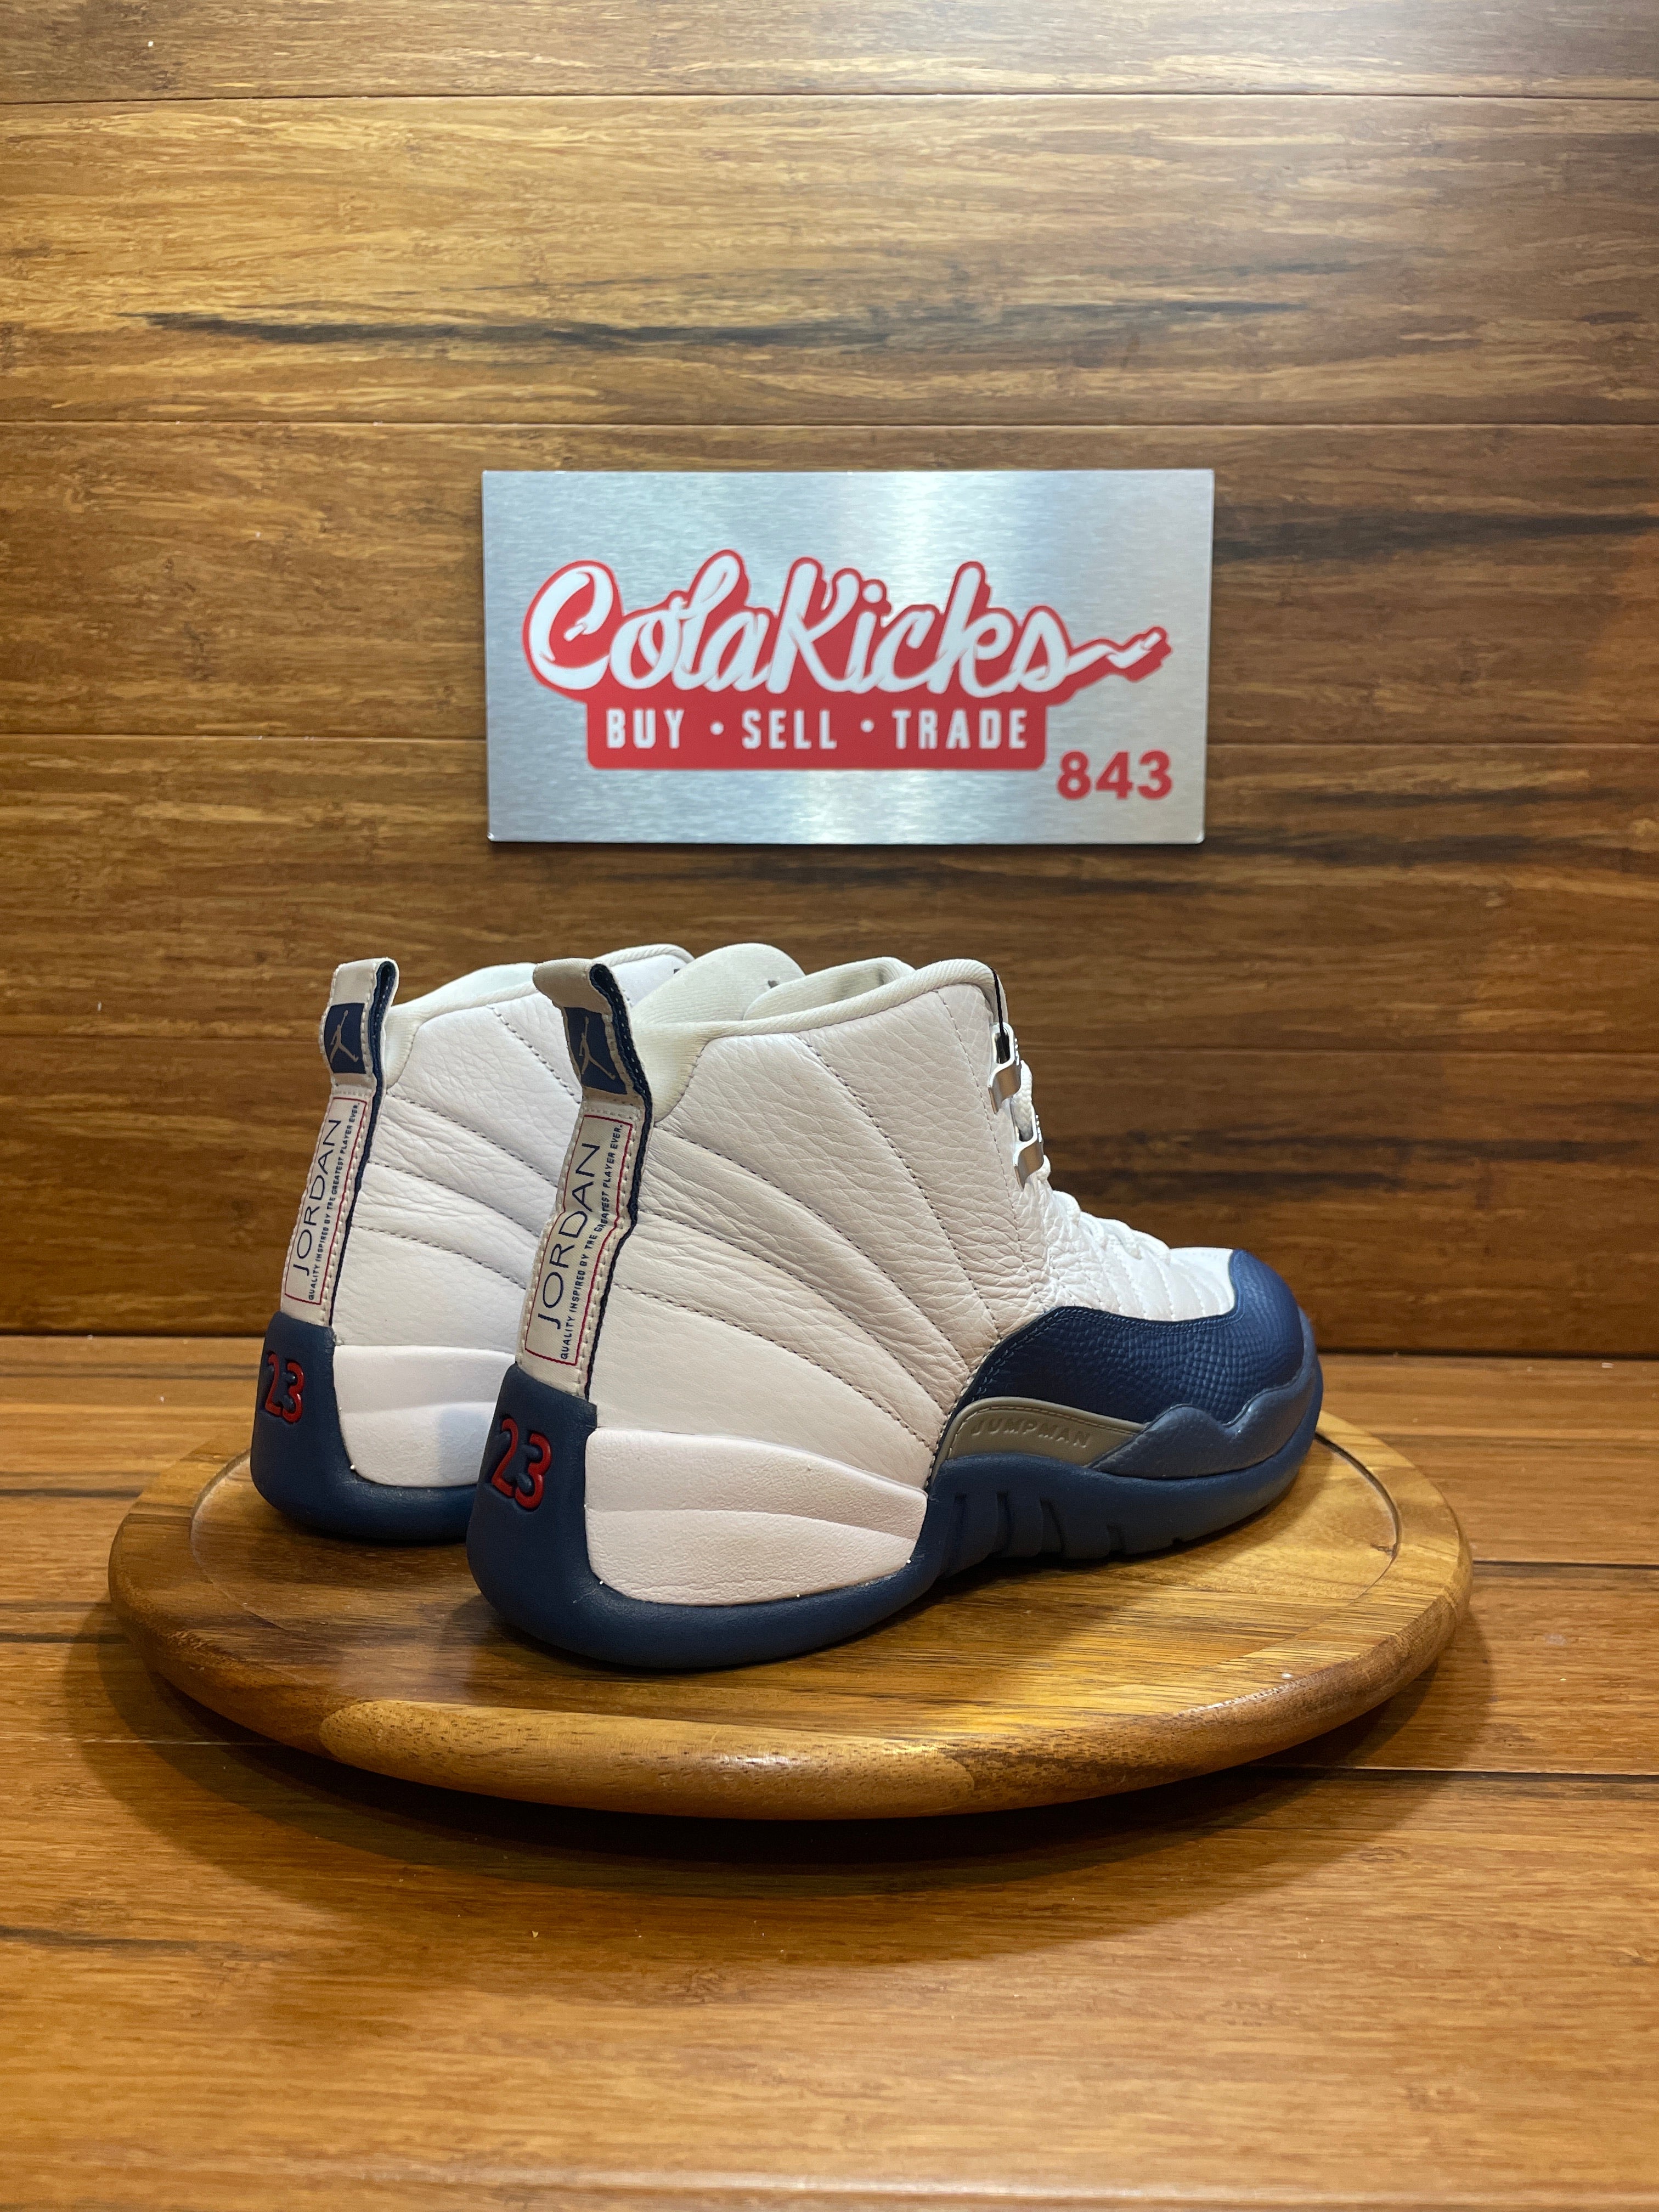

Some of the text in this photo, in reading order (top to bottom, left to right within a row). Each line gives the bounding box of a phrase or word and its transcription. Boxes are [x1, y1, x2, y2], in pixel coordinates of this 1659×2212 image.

[527, 552, 1166, 699] ColaKicks
[606, 709, 1028, 751] BUY SELL TRADE
[1057, 751, 1173, 800] 843
[340, 1125, 353, 1154] PLAYER
[332, 1157, 344, 1195] GREATEST
[293, 1120, 341, 1276] JORDAN
[324, 1214, 331, 1224] BY
[327, 1197, 336, 1210] THE
[315, 1227, 329, 1262] INSPIRED
[538, 1143, 600, 1329] JORDAN
[560, 1125, 623, 1359] QUALITY INSPIRED BY THE GREATEST PLAYER EVER.
[309, 1265, 320, 1300] QUALITY
[265, 1353, 305, 1423] 23
[970, 1417, 1092, 1449] JUMPMAN
[492, 1418, 552, 1510] 23
